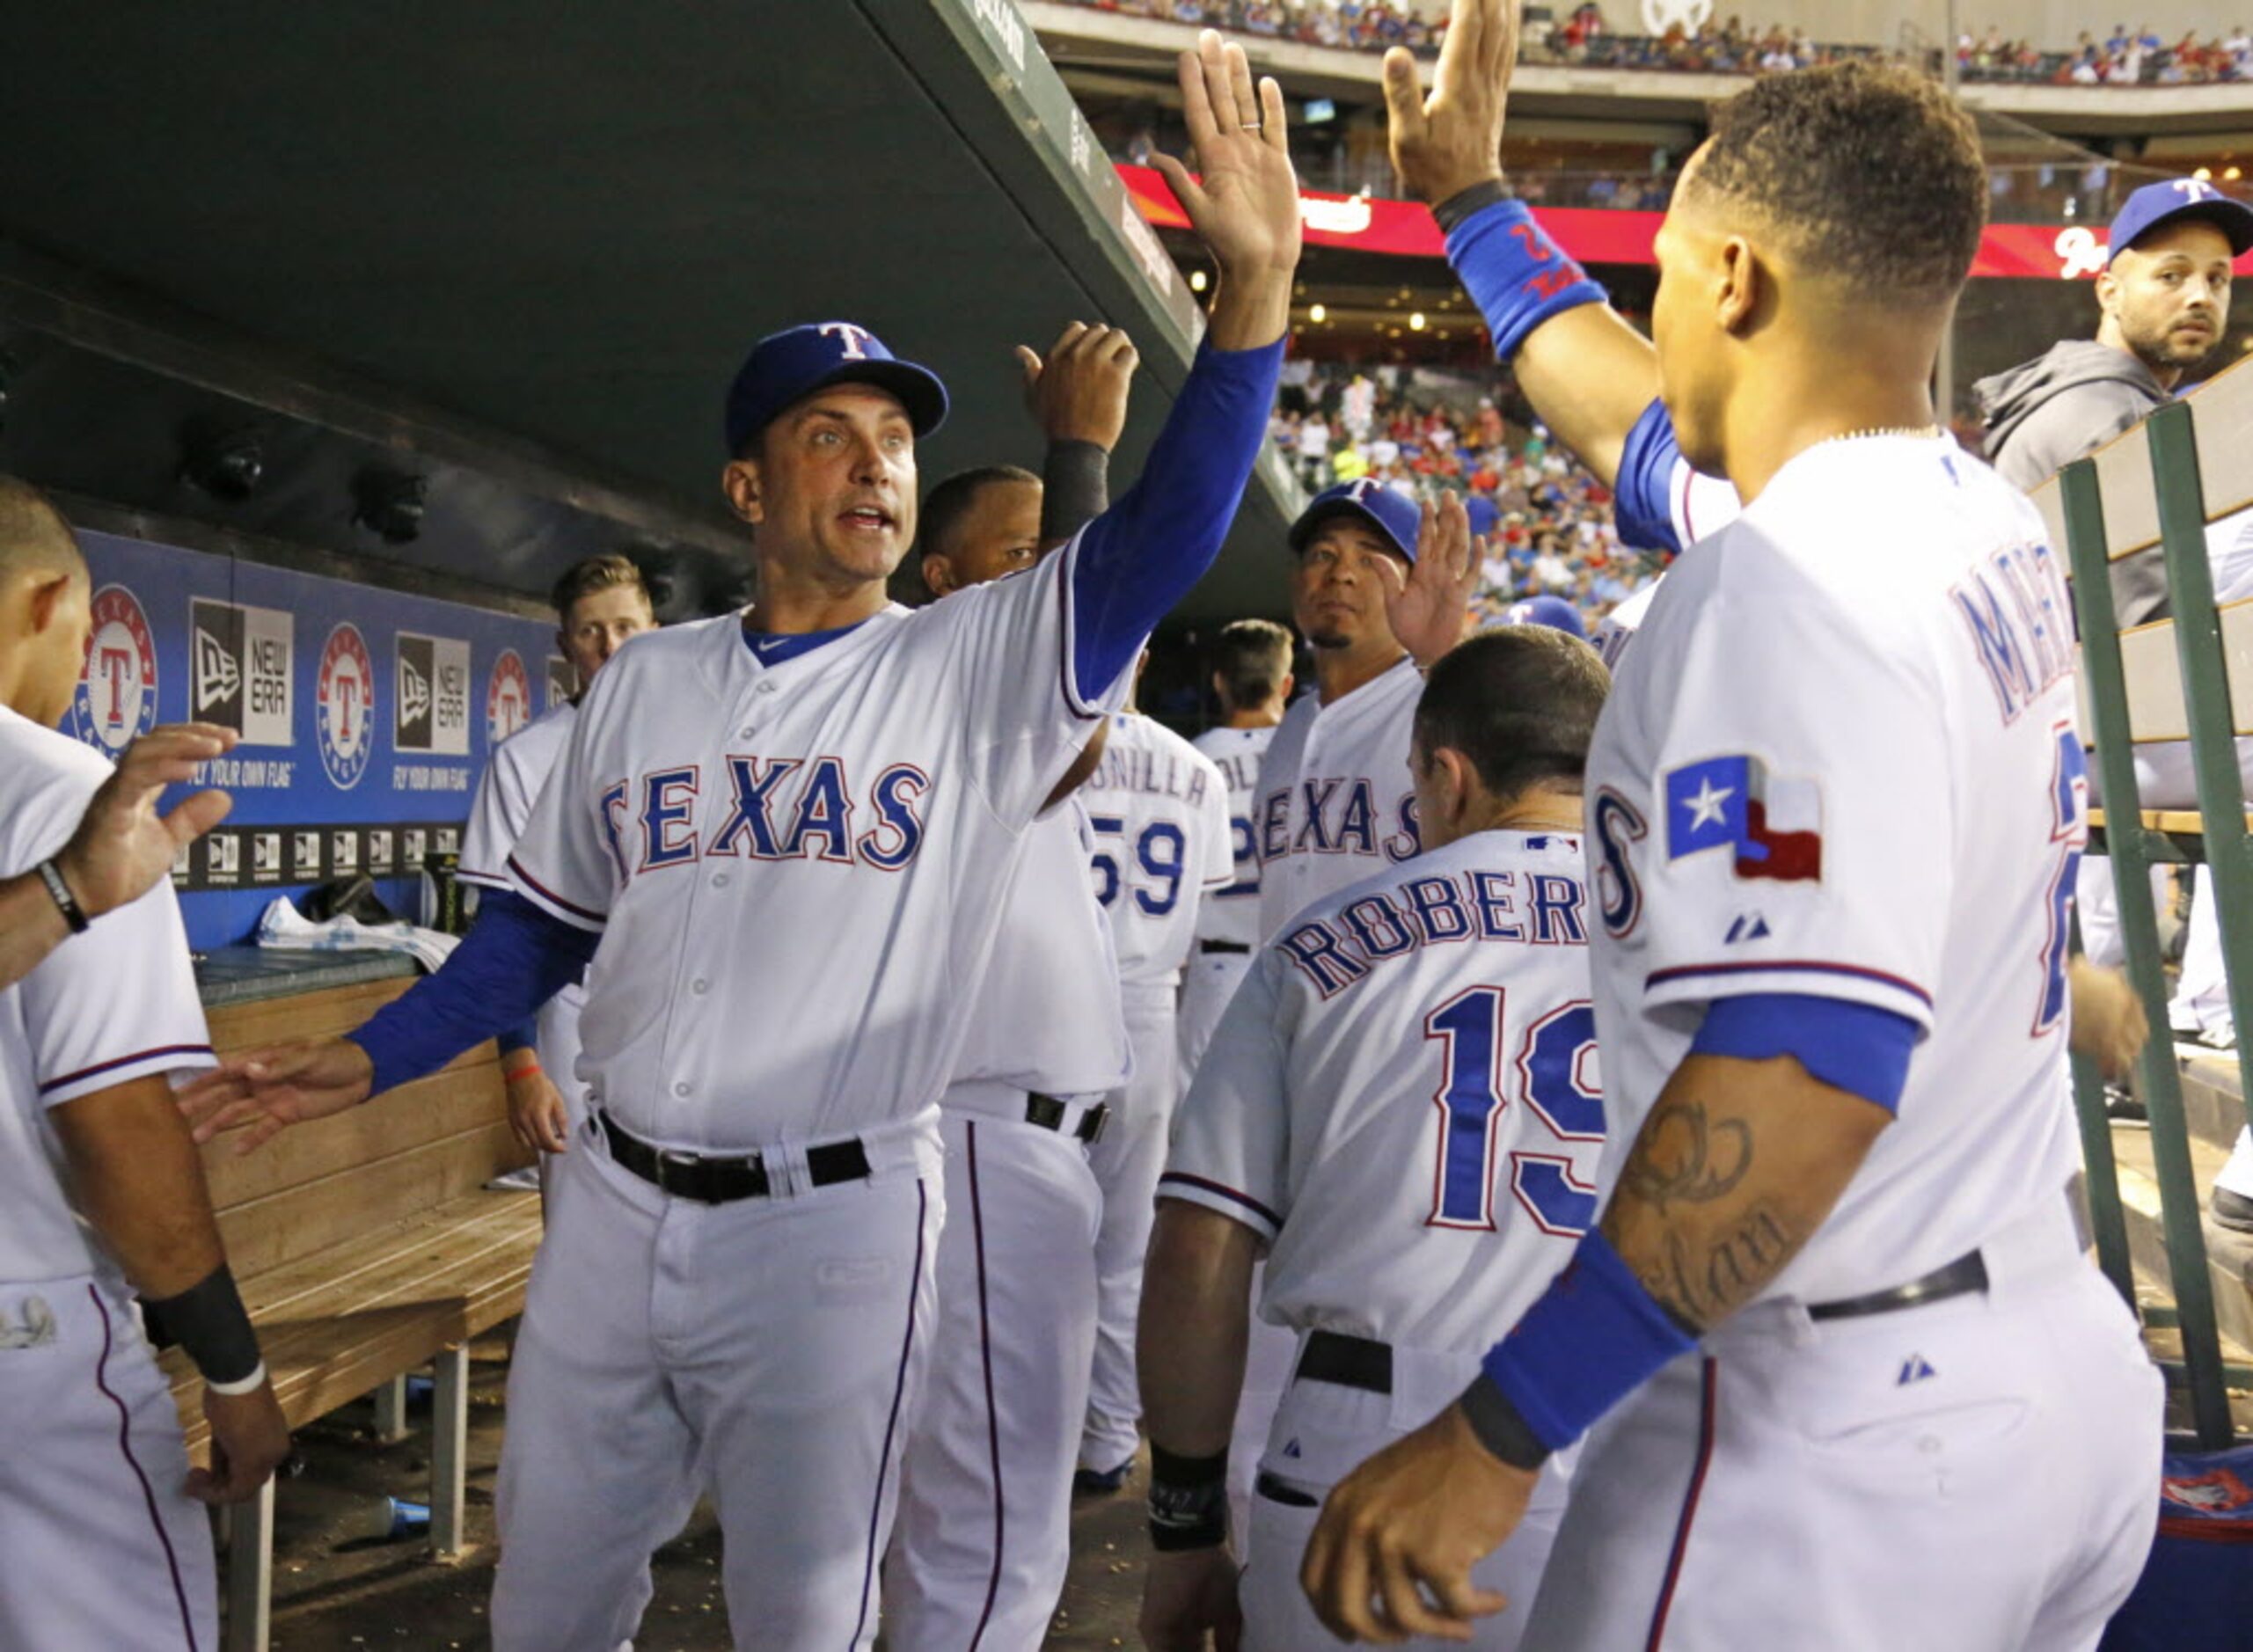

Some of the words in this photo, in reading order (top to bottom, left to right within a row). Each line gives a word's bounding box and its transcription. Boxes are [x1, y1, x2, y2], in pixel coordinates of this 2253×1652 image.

[2172, 177, 2213, 204] T
[817, 322, 874, 361] T
[1349, 476, 1383, 502] T
[252, 637, 287, 676] NEW
[100, 647, 132, 728] T
[252, 677, 286, 715] ERA
[336, 676, 356, 742] T
[242, 760, 267, 788] OWN
[267, 761, 291, 787] FLAG
[1078, 746, 1209, 808] ONILLA
[1253, 778, 1423, 866] EXAS
[1087, 811, 1186, 919] 59
